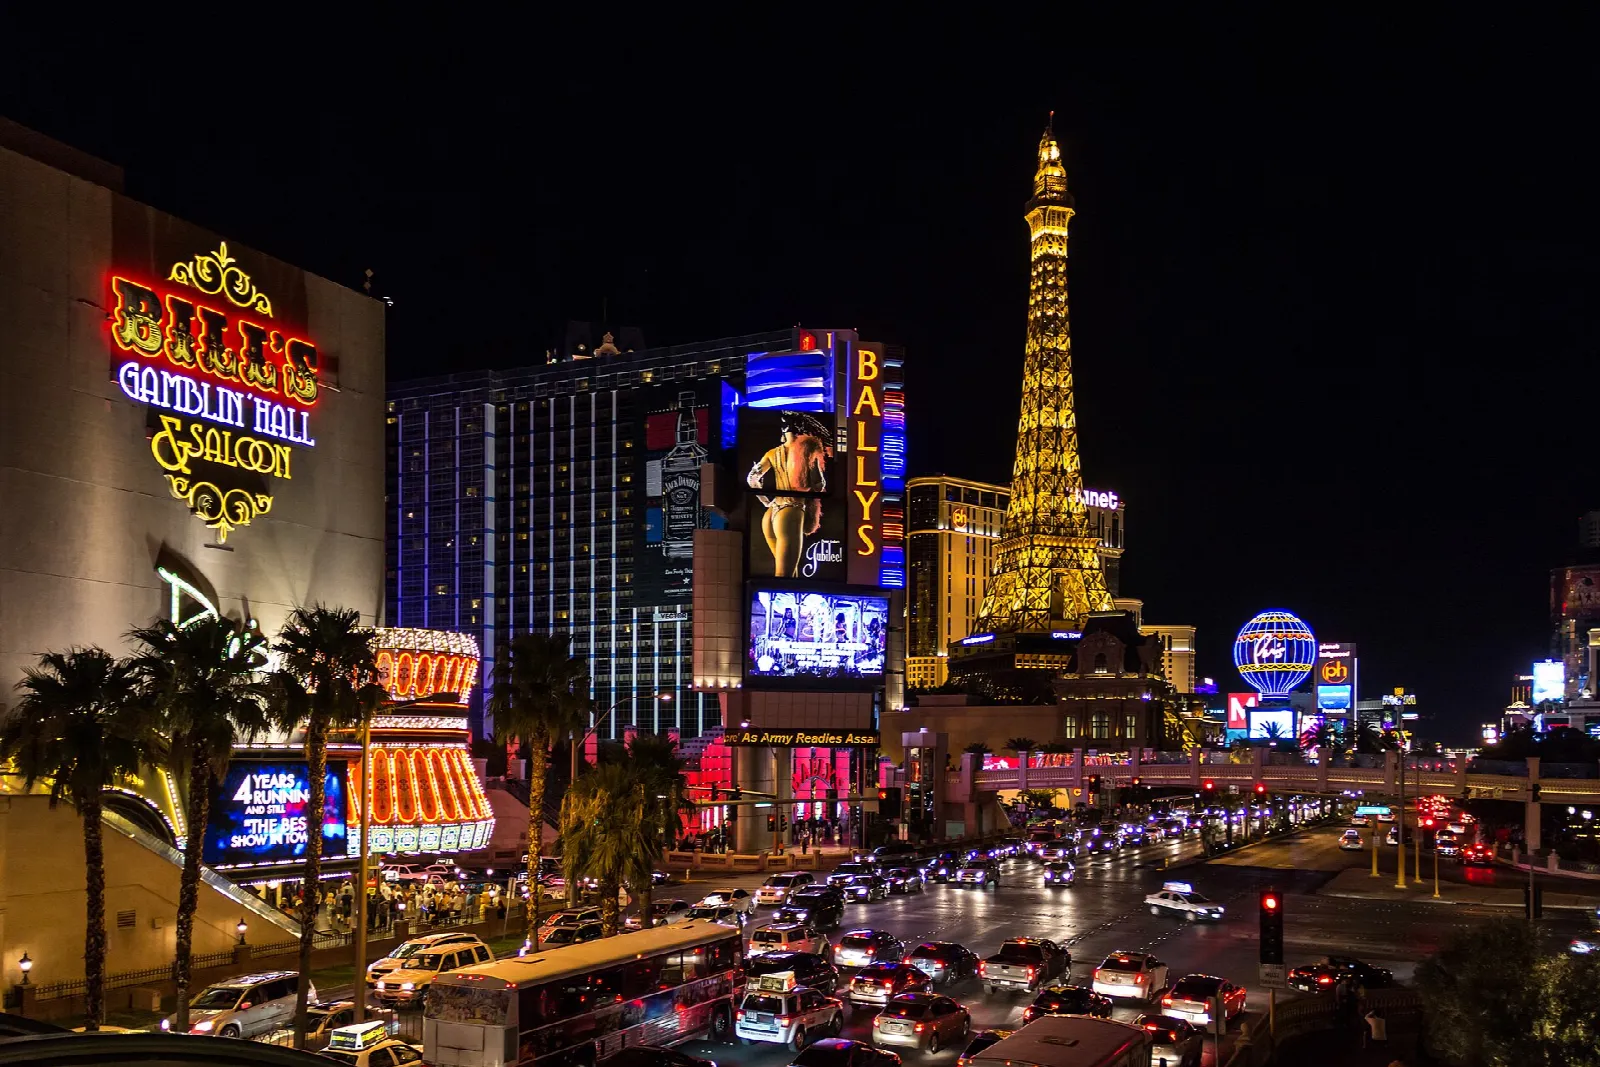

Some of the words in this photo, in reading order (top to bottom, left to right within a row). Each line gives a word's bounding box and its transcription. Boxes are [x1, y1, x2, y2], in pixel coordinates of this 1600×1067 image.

[111, 276, 318, 406] BILL'S
[119, 362, 253, 428] GAMBLIN'
[254, 400, 315, 447] HALL
[151, 414, 192, 475] &
[187, 424, 292, 480] SALOON
[802, 541, 842, 578] Jubilee!
[1325, 660, 1348, 681] ph
[742, 732, 758, 743] As
[761, 732, 793, 745] Army
[795, 732, 842, 744] Readies
[232, 773, 252, 805] 4
[252, 773, 296, 789] YEARS
[253, 788, 310, 805] RUNNIN
[245, 805, 265, 815] AND
[266, 804, 287, 815] STILL
[281, 816, 308, 833] BES
[230, 833, 269, 848] SHOW
[269, 831, 284, 845] IN
[285, 831, 309, 845] TOW
